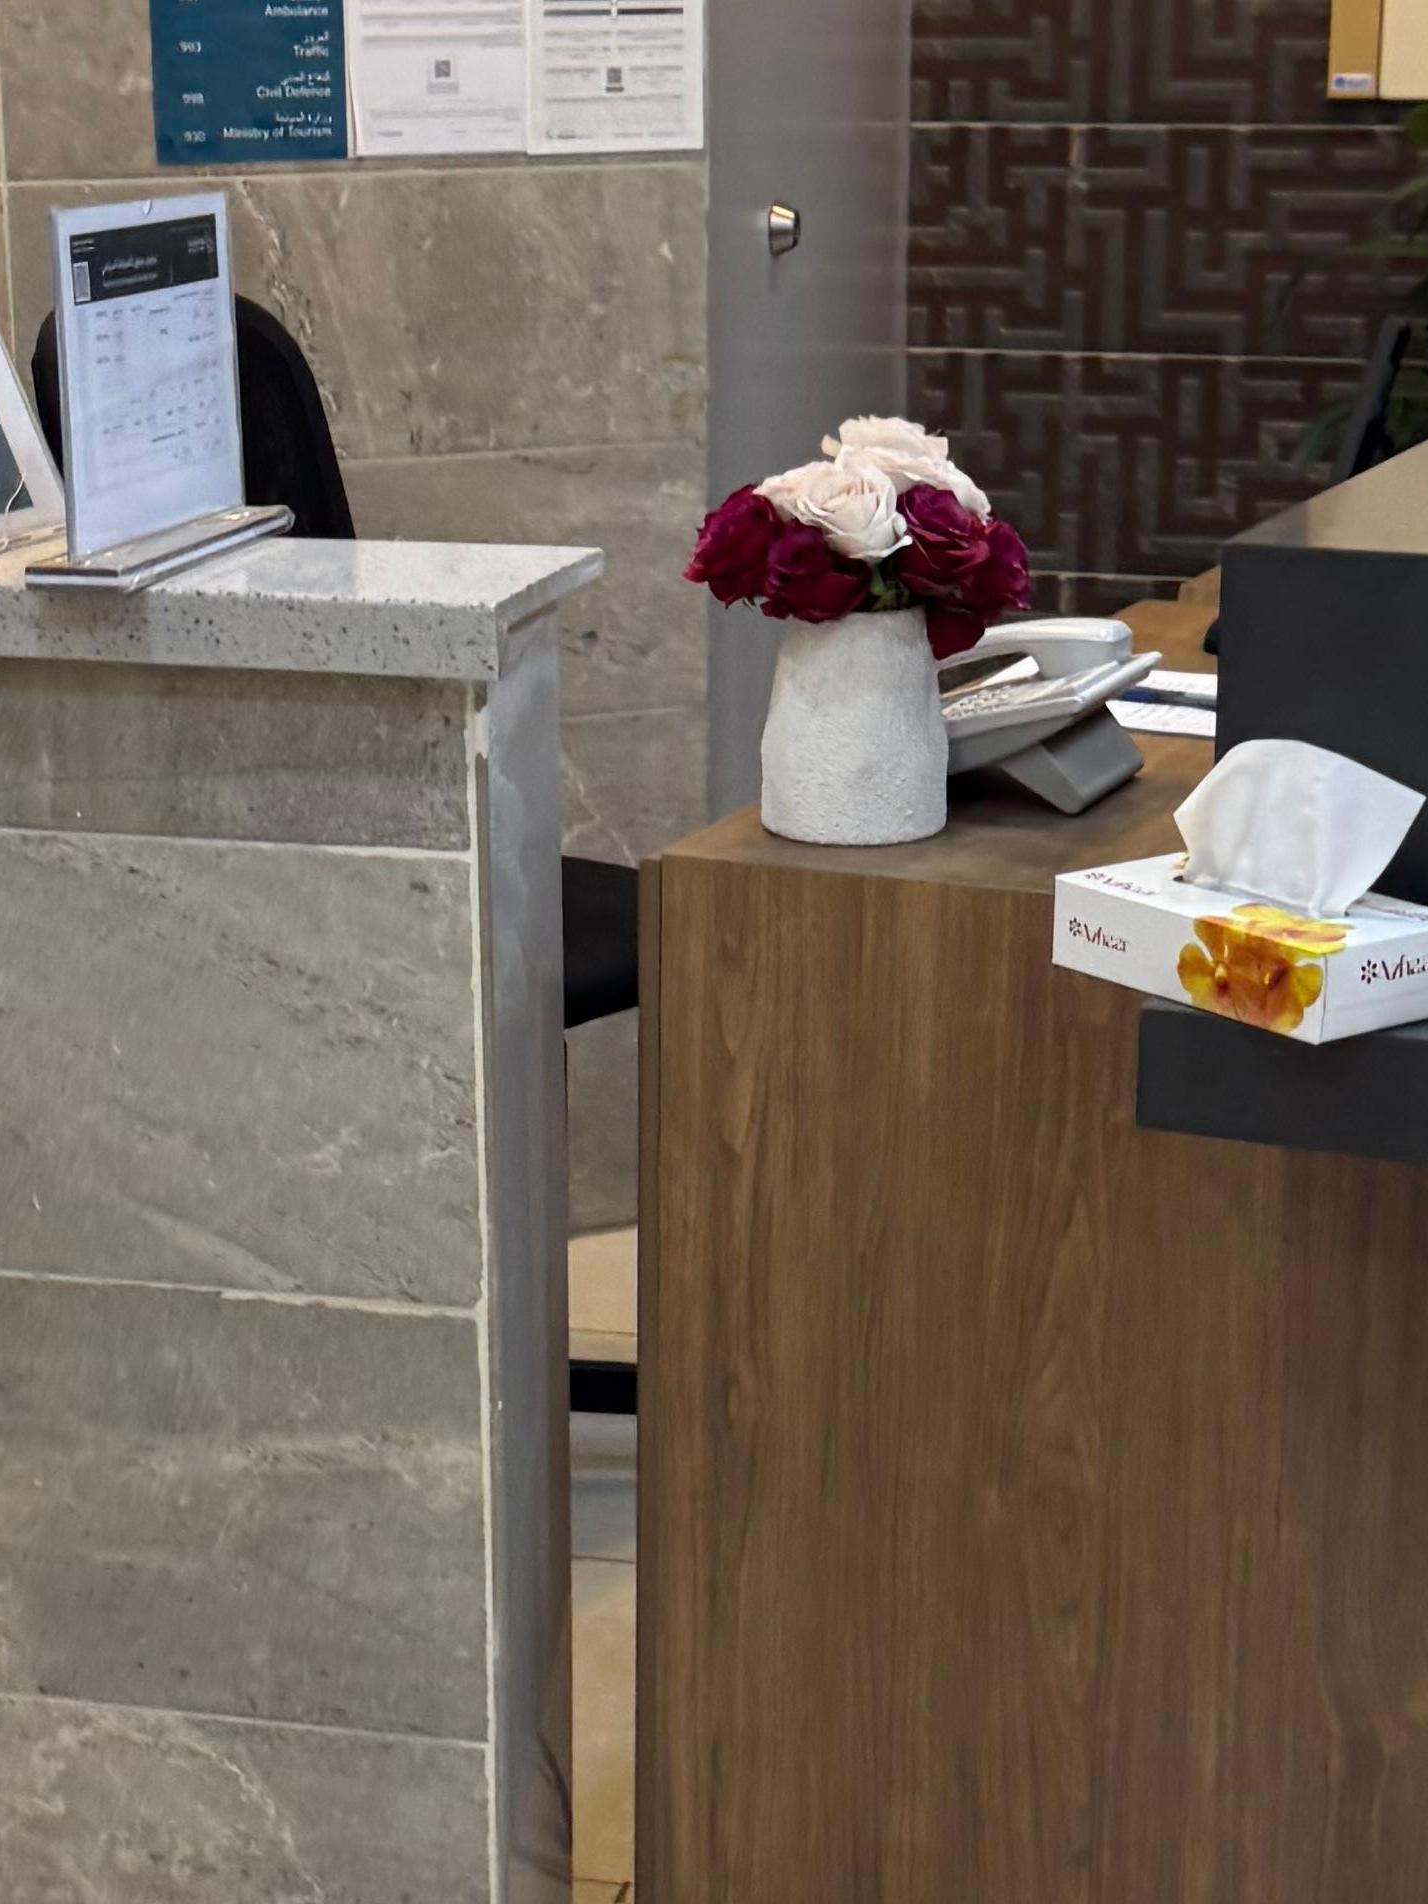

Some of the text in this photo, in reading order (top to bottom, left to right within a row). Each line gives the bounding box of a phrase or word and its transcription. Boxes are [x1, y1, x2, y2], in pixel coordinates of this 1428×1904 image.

[265, 4, 328, 16] Ambulance
[293, 45, 329, 57] Traffic
[256, 86, 282, 99] Civil
[223, 125, 332, 141] Ministry of Tourism
